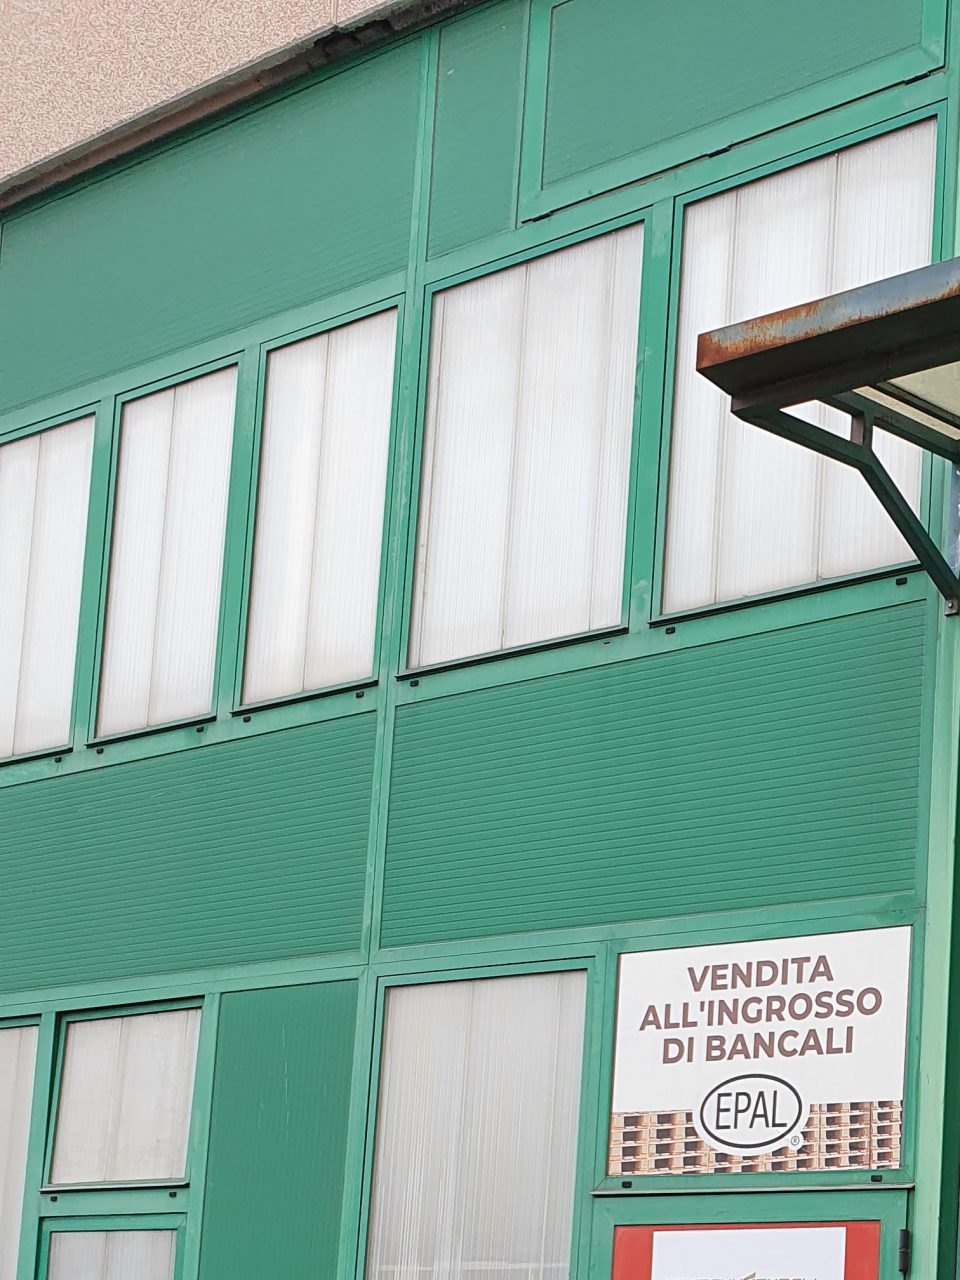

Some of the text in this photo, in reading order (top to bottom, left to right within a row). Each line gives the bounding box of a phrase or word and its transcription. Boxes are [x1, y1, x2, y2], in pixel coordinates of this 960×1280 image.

[687, 954, 834, 993] VENDITA
[638, 986, 883, 1032] ALL'INGROSSO
[662, 1026, 854, 1065] DI BANCALI
[714, 1089, 788, 1130] EPAL
